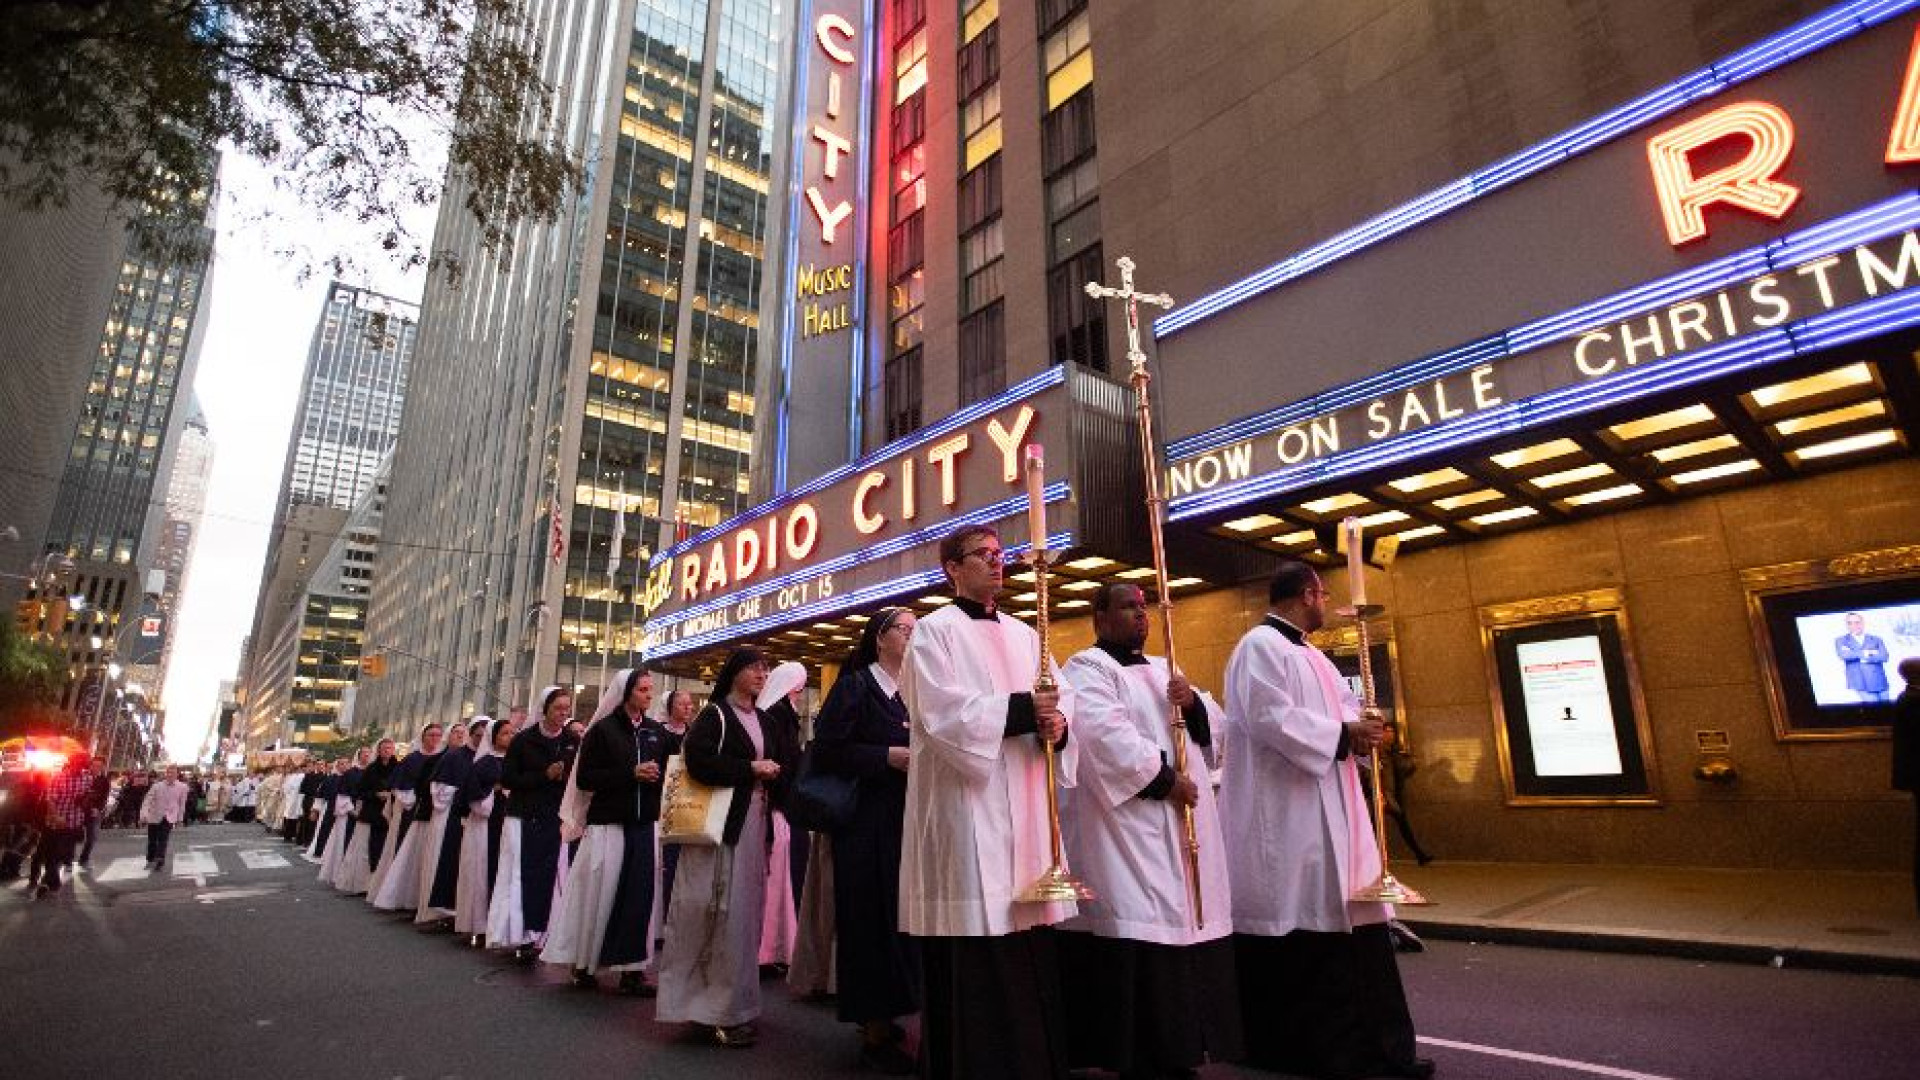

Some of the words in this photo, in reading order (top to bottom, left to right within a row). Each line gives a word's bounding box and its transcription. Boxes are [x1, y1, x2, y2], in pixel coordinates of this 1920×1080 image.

[806, 14, 854, 243] CITY
[1646, 20, 1920, 246] R
[1573, 229, 1920, 376] CHRISTM
[680, 504, 818, 601] RADIO
[852, 404, 1035, 535] CITY
[1170, 444, 1252, 496] NOW
[1277, 417, 1340, 464] ON
[1366, 364, 1503, 439] SALE
[737, 597, 761, 621] CHE
[777, 583, 809, 609] OCT
[818, 574, 833, 600] 15
